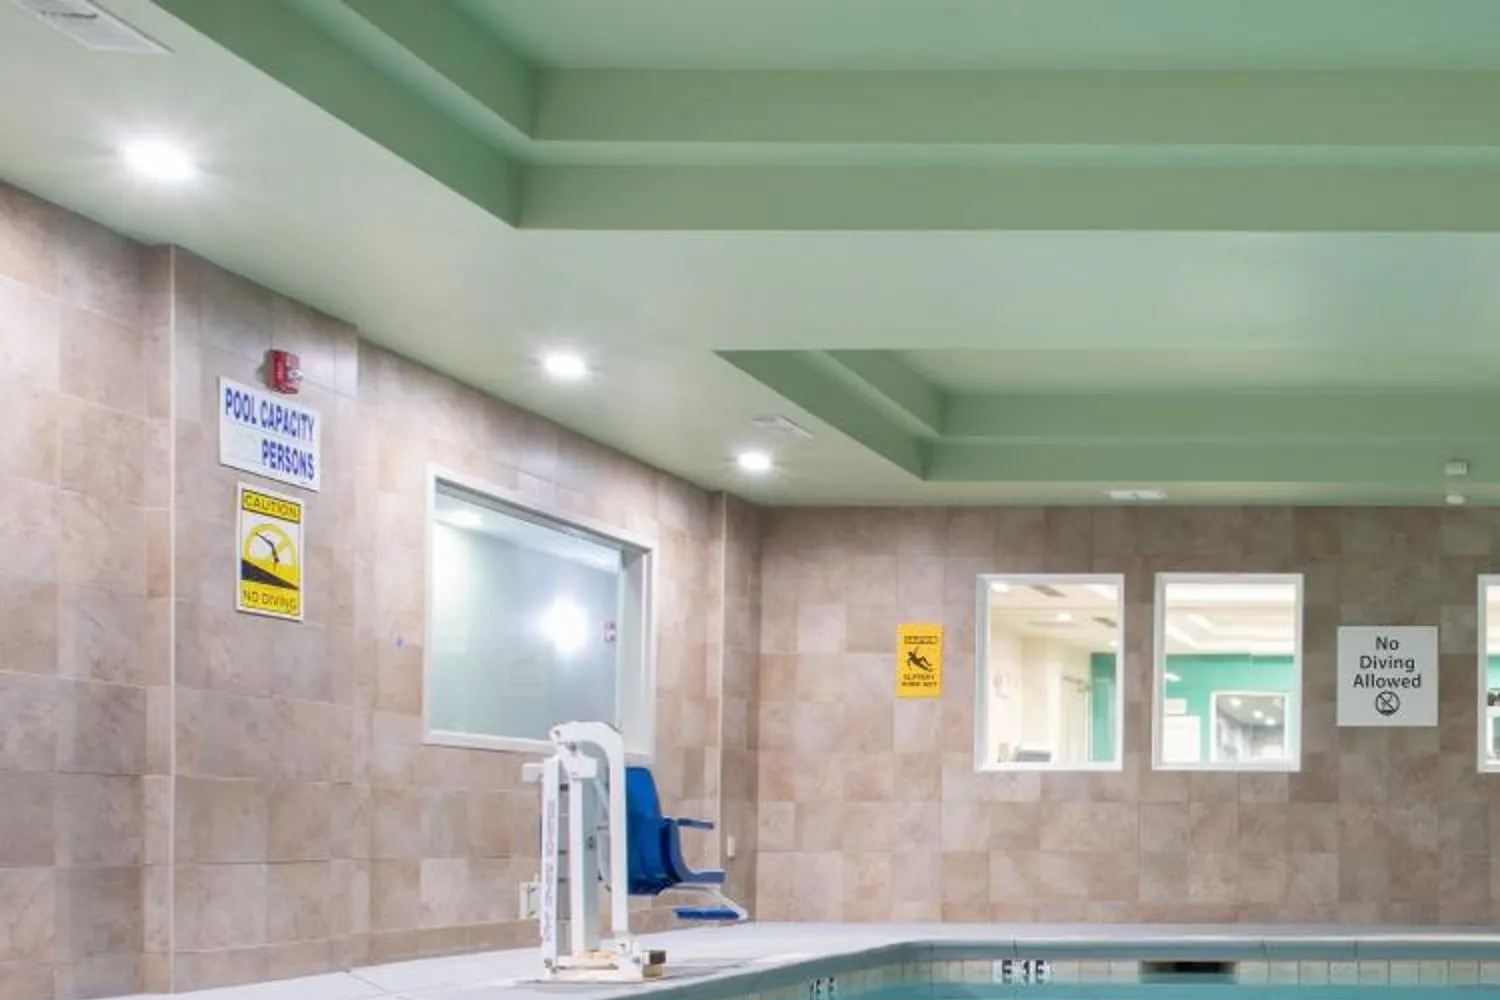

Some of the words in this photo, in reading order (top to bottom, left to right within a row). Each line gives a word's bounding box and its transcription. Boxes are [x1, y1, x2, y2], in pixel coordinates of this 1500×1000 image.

[225, 387, 257, 424] POOL
[260, 399, 314, 442] CAPACITY
[262, 438, 314, 481] PERSONS
[244, 495, 297, 518] CAUTION
[243, 589, 259, 603] NO
[261, 592, 297, 610] DIVING
[1375, 636, 1399, 651] No
[1359, 655, 1415, 673] Diving
[1353, 673, 1422, 689] Allowed
